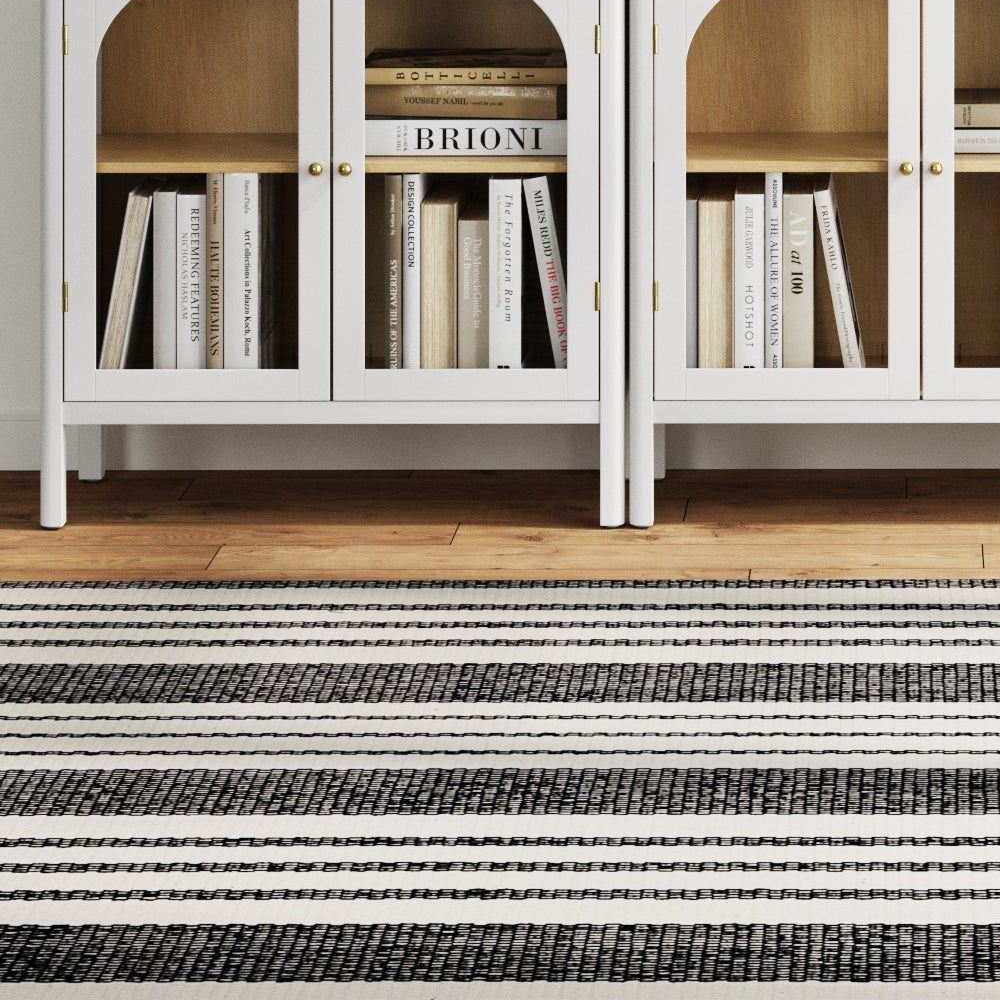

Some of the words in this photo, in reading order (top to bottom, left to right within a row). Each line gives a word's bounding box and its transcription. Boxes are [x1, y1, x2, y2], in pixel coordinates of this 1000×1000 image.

[396, 72, 534, 81] BOTTICELLI
[404, 96, 442, 105] YOUSSEF
[443, 97, 466, 105] NABIL
[414, 128, 543, 150] BRIONI
[505, 194, 513, 215] The
[534, 190, 547, 224] MILES
[745, 206, 754, 228] JULIE
[244, 229, 252, 241] Art
[770, 217, 779, 238] THE
[789, 211, 808, 246] AD
[821, 205, 831, 235] FRIDA
[827, 237, 838, 270] KAHLO
[191, 208, 200, 278] REDEEMING
[473, 238, 482, 254] The
[503, 222, 513, 282] Forgotten
[540, 226, 552, 256] REDD
[745, 231, 754, 269] GARWOOD
[210, 241, 219, 281] HAUTE
[244, 242, 252, 279] Collections
[546, 258, 558, 282] THE
[770, 241, 779, 283] ALLURE
[791, 250, 802, 265] at
[550, 285, 561, 304] BIG
[770, 287, 779, 301] OF
[791, 271, 804, 294] 100
[191, 283, 200, 342] FEATURES
[244, 289, 252, 315] Palazzo
[505, 289, 513, 322] Room
[210, 286, 219, 356] BOHEMIANS
[244, 316, 252, 336] Koch,
[553, 307, 566, 338] BOOK
[745, 285, 754, 347] HOTSHOT
[770, 304, 779, 346] WOMEN
[390, 328, 397, 340] OF
[244, 338, 252, 357] Rome
